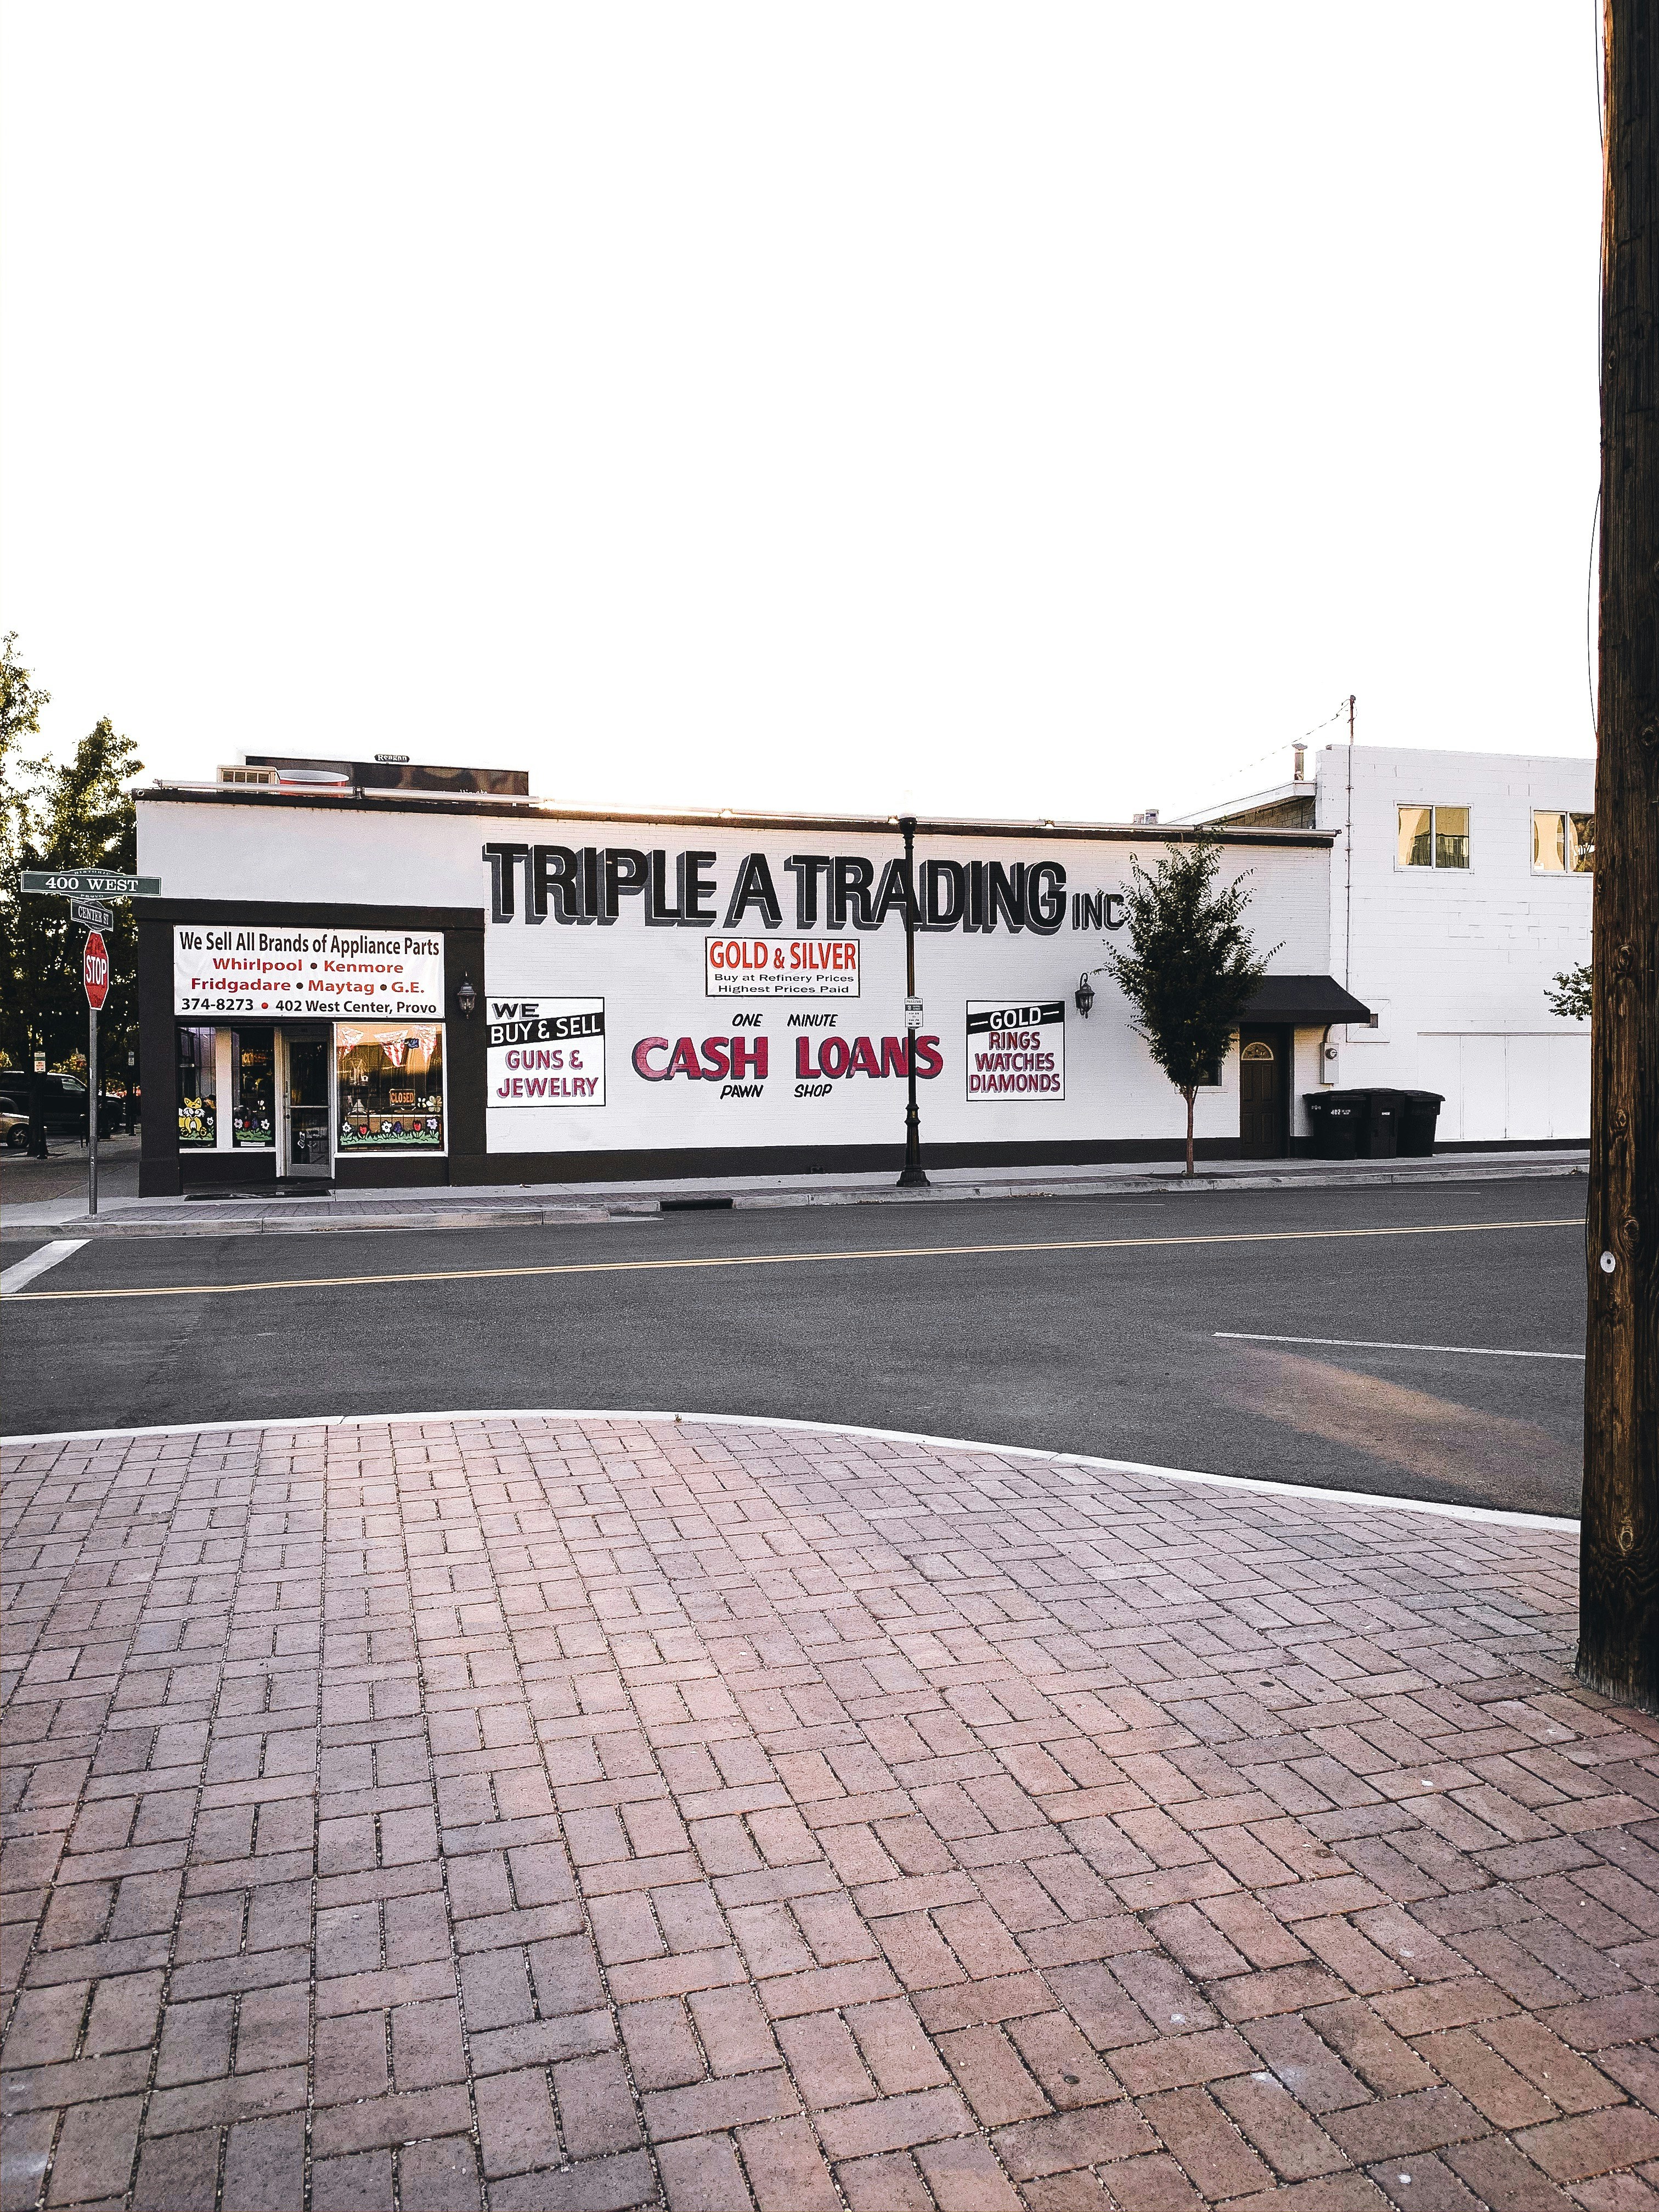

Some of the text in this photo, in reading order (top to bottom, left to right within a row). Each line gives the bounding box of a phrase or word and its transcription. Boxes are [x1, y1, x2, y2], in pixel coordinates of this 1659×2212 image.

[45, 877, 139, 892] 400 WEST
[482, 843, 718, 928] TRIPLE
[723, 853, 783, 929] A
[783, 854, 1068, 935] TRADING
[78, 906, 109, 926] CENTER ST
[179, 931, 439, 958] We Sell All Brands of Appliance Parts
[709, 941, 856, 970] GOLD & SILVER
[86, 955, 107, 985] STOP
[212, 958, 404, 974] Whirlpool Kenmore
[191, 978, 425, 996] Fridgadare Maytag G.E.
[715, 974, 738, 983] Buy
[759, 974, 812, 983] Refinery
[816, 974, 855, 983] Prices
[718, 985, 773, 994] Highest
[181, 998, 437, 1015] 374-8273 402 West Center, Provo
[491, 1003, 540, 1020] WE
[732, 1013, 838, 1028] ONE MINUTE
[990, 1007, 1041, 1030] GOLD
[491, 1015, 601, 1045] BUY & SELL
[989, 1031, 1041, 1051] RINGS
[505, 1049, 583, 1071] GUNS &
[631, 1035, 944, 1082] CASH LOANS
[974, 1052, 1055, 1072] WATCHES
[496, 1077, 599, 1099] JEWELRY
[720, 1084, 833, 1100] PAWN SHOP
[969, 1073, 1061, 1093] DIAMONDS
[391, 1092, 414, 1103] CLOSED
